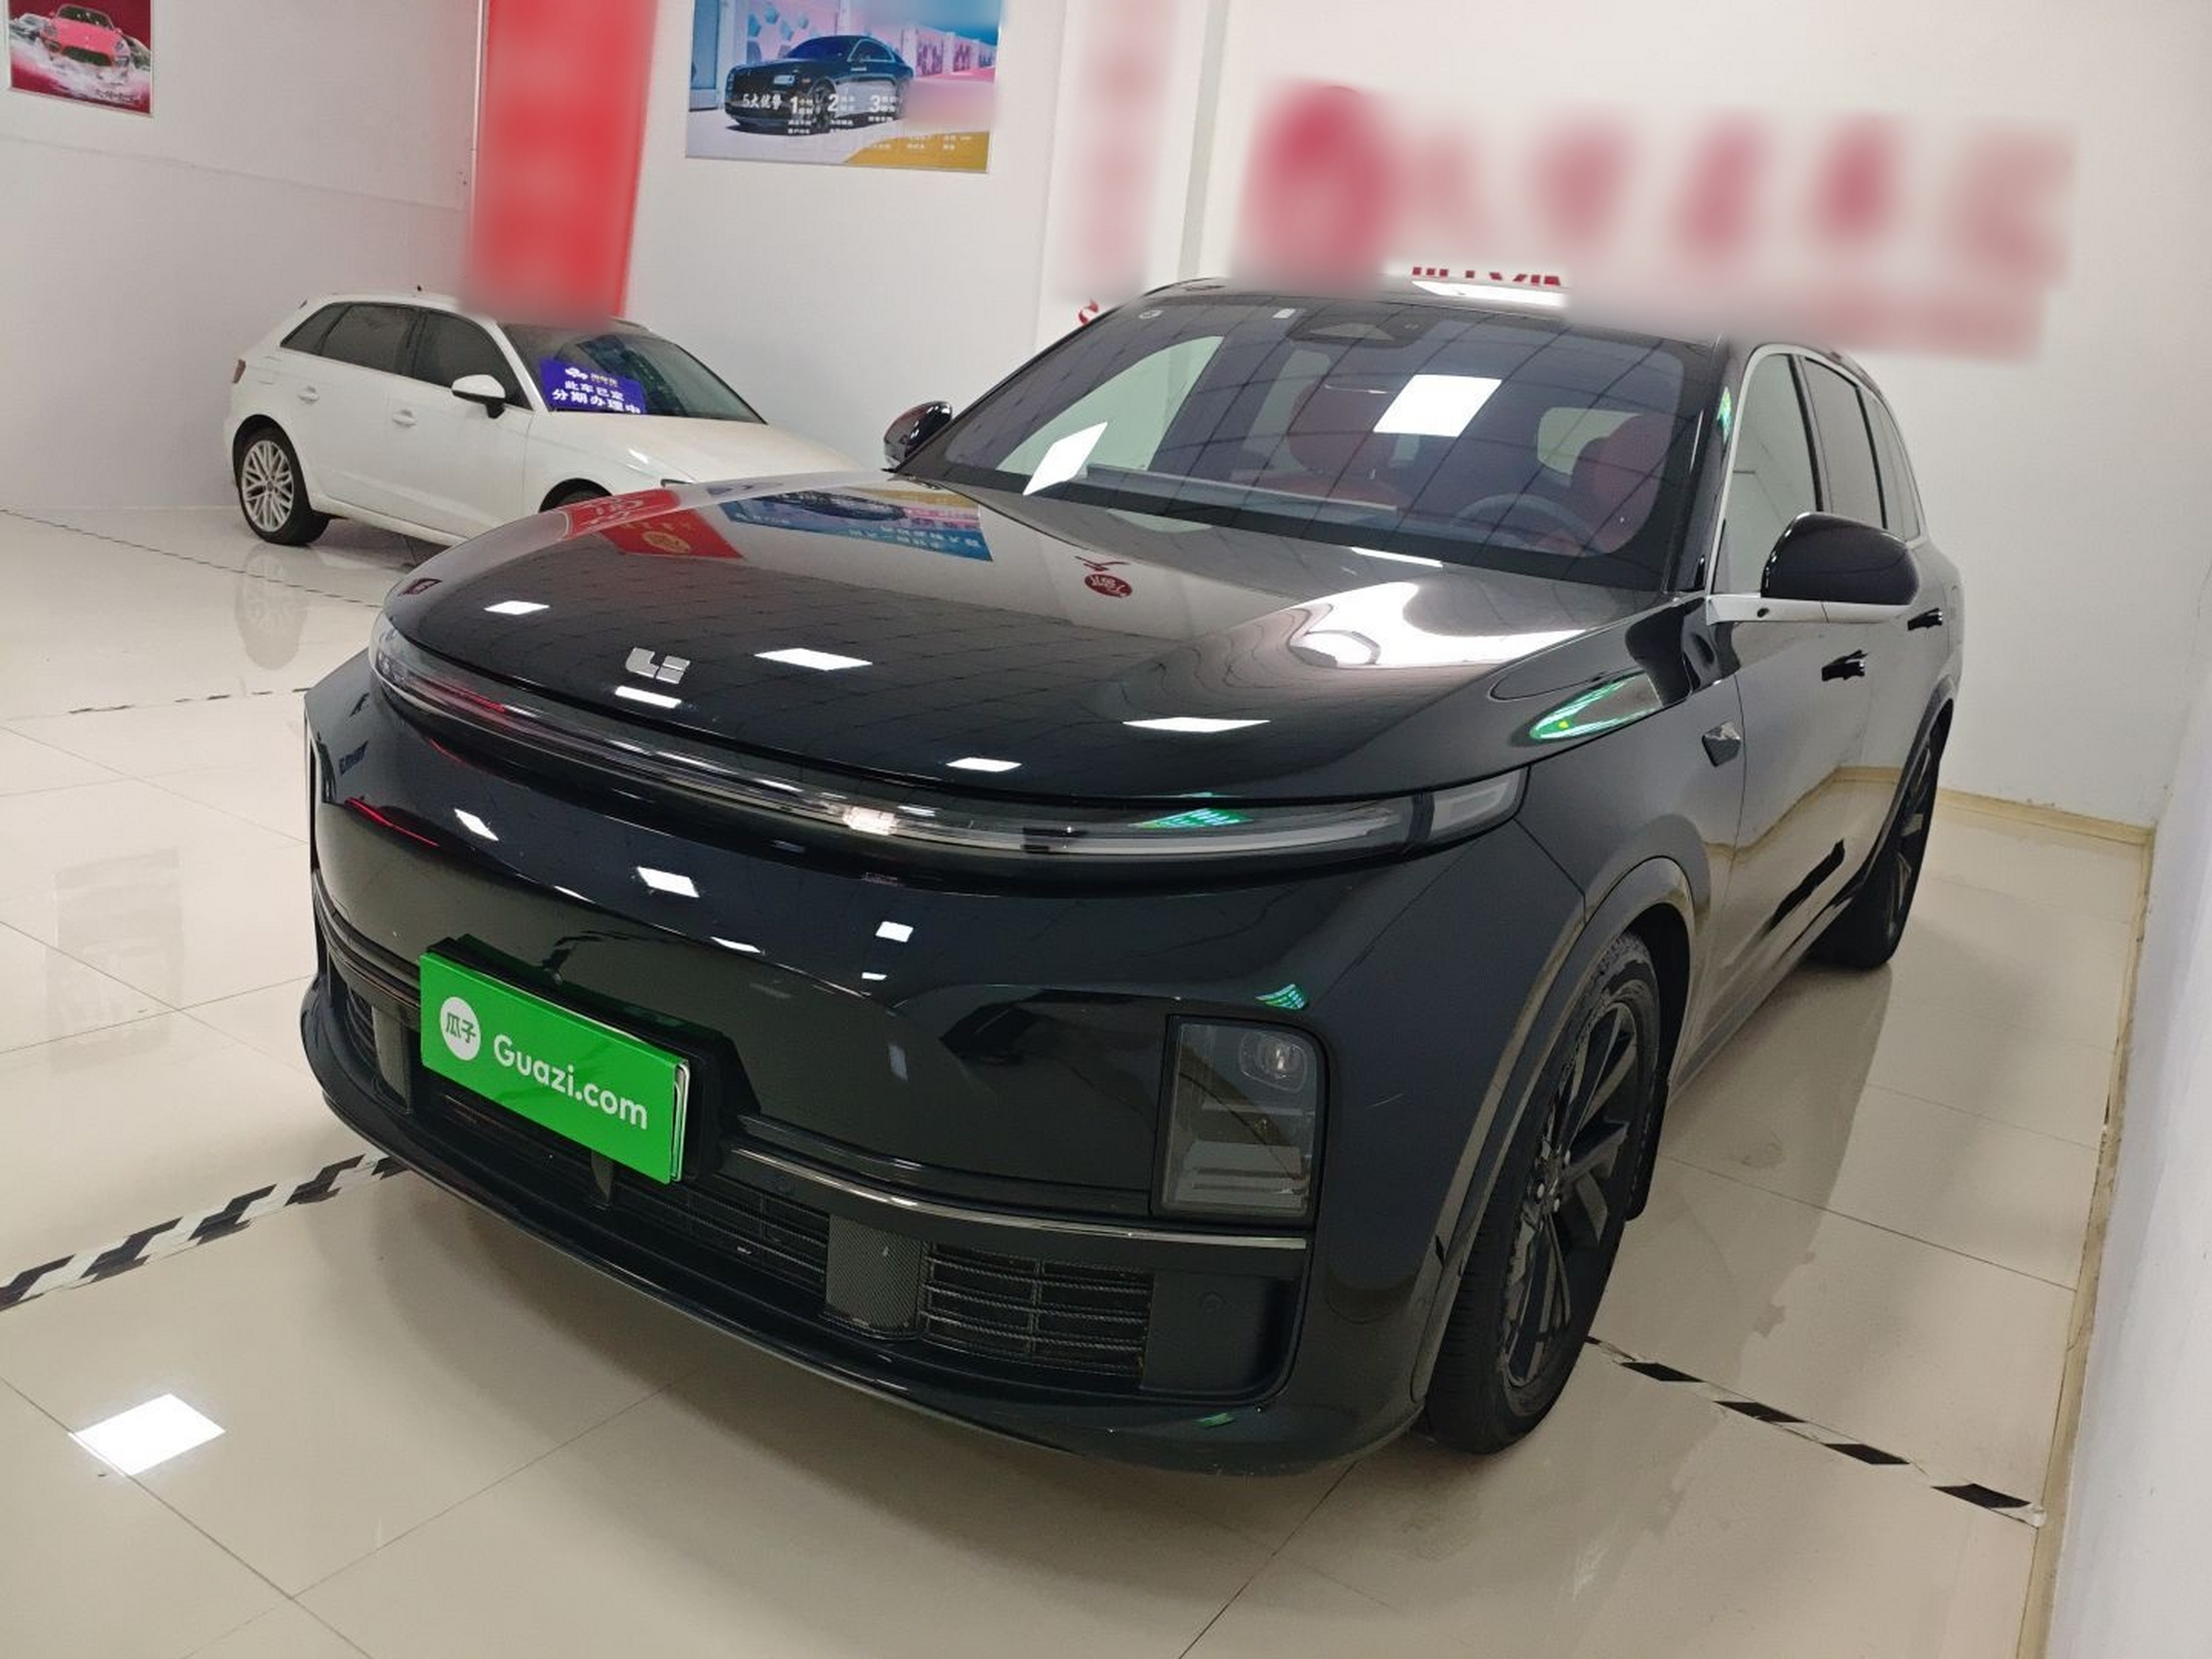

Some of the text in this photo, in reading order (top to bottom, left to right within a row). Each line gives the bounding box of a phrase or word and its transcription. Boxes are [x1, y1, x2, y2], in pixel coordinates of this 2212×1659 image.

[552, 389, 641, 414] 分期办理中
[446, 1012, 476, 1044] 瓜子
[493, 1034, 647, 1130] Guazi.com
